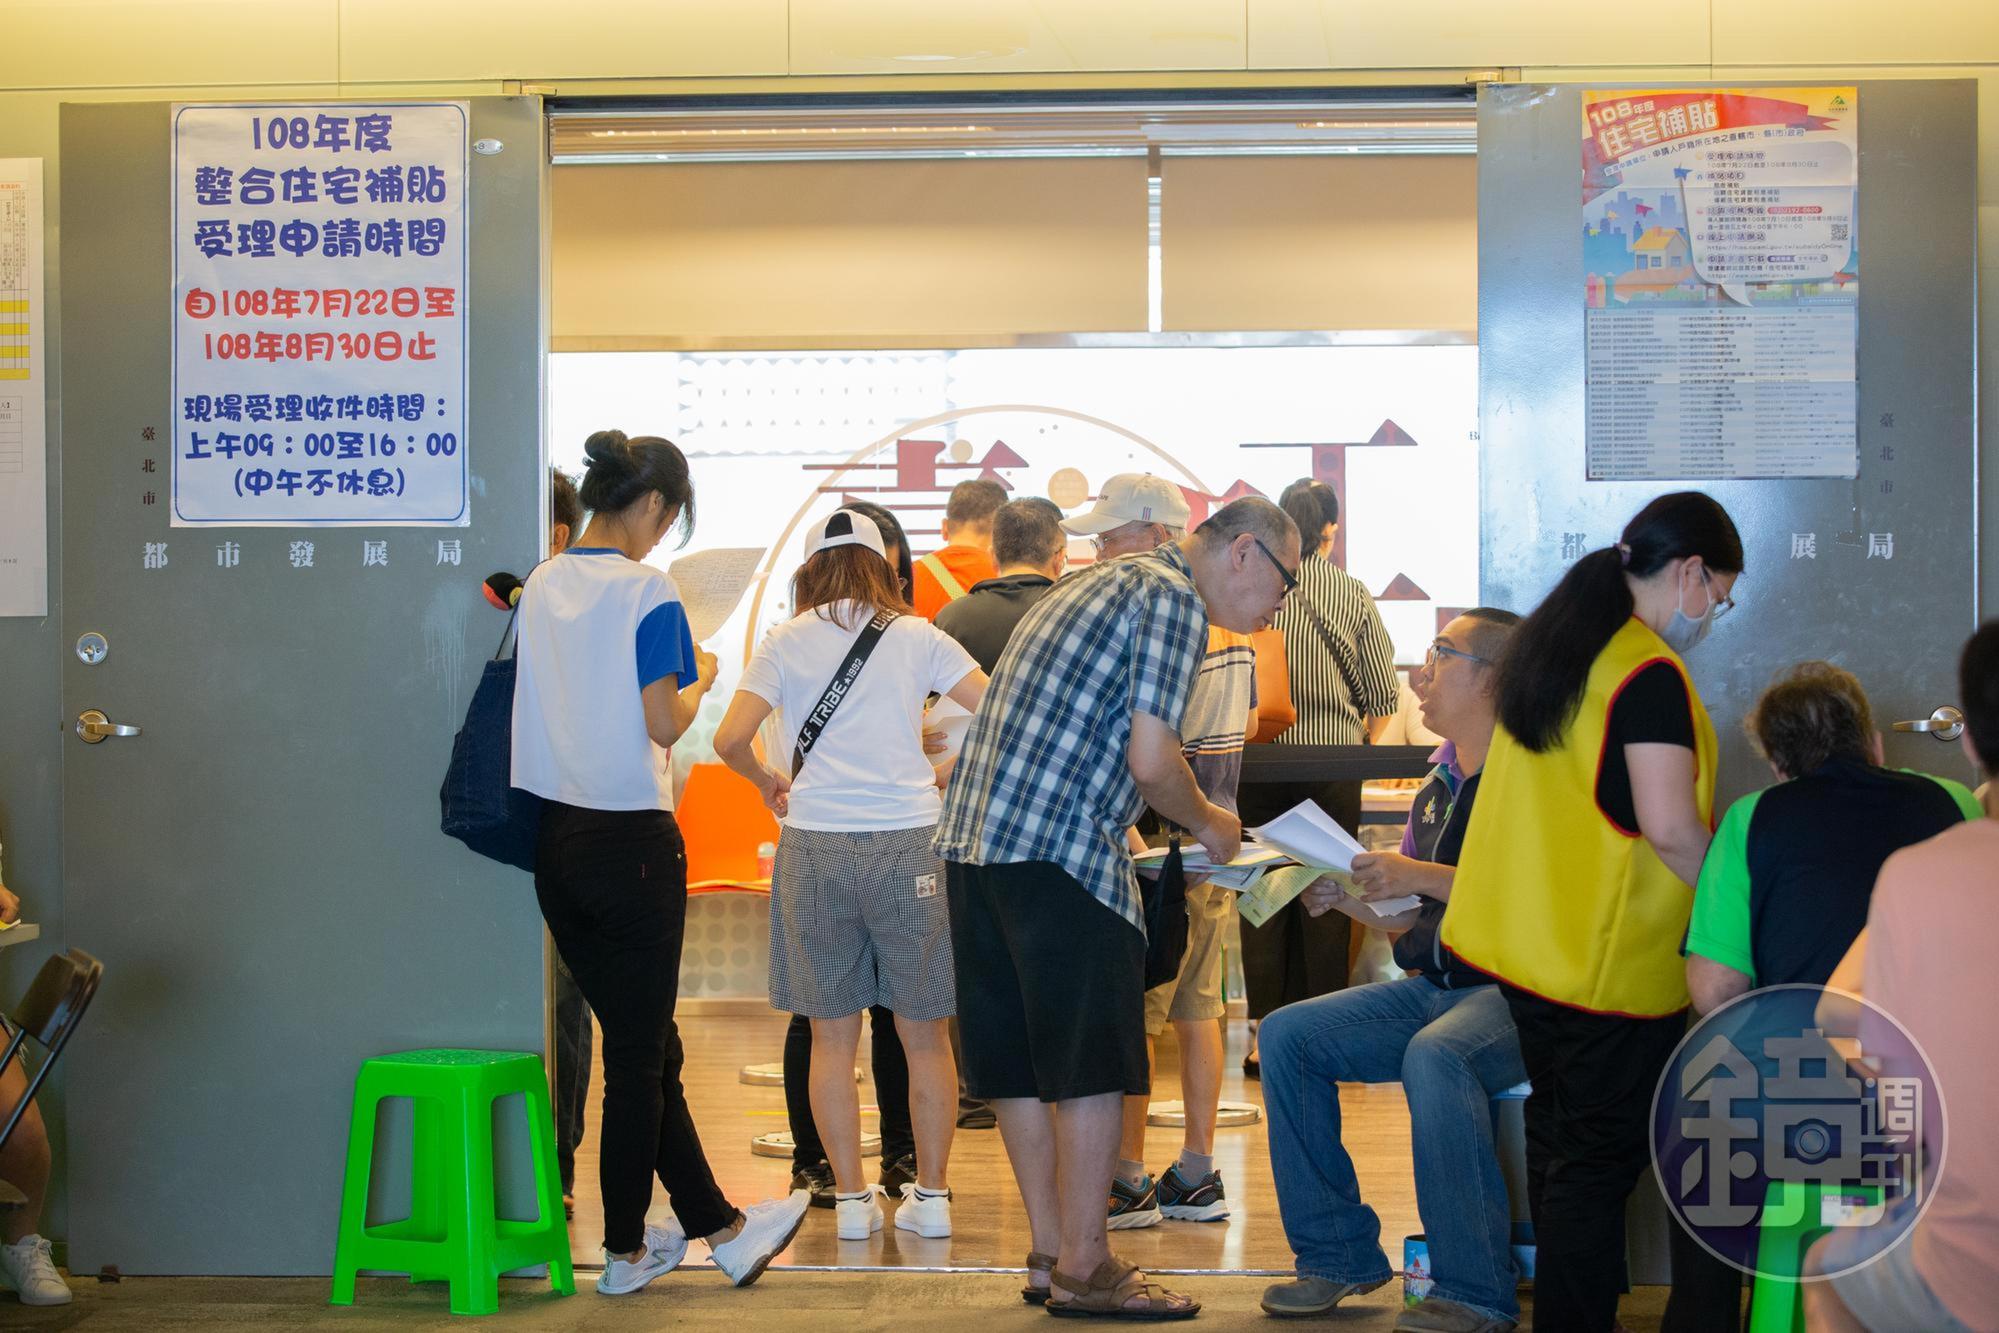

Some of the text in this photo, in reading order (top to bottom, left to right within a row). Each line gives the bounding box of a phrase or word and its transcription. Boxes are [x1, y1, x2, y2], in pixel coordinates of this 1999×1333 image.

[253, 113, 392, 153] 108年度
[1599, 99, 1719, 158] 住宅補貼
[194, 166, 446, 206] 整合住宅補貼
[193, 218, 447, 259] 受理申請時間
[184, 287, 456, 320] 自108年7月22日至
[204, 331, 437, 363] 108年8月30日止
[183, 393, 447, 422] 現場受理收件時間：
[184, 431, 457, 460] 上午09：00至16：00
[141, 426, 157, 506] 臺北市
[234, 467, 406, 498] (中午不休息)
[142, 539, 462, 568] 都市發展局
[808, 680, 848, 728] TRIBE
[846, 657, 864, 680] 1992
